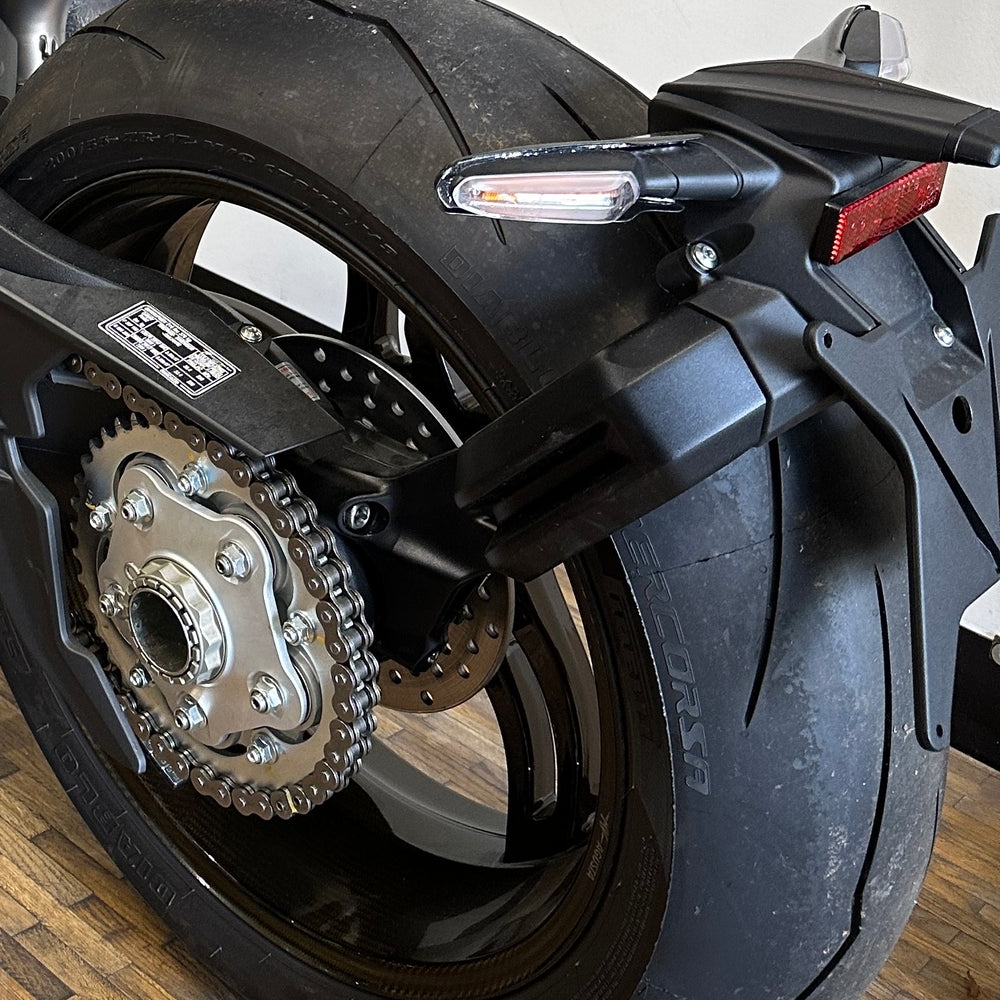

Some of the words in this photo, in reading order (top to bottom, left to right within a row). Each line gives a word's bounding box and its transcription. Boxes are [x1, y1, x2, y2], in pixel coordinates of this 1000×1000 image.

[621, 518, 711, 796] ERCORSA
[55, 745, 178, 908] DIABLO
[587, 841, 603, 882] AGUSTA
